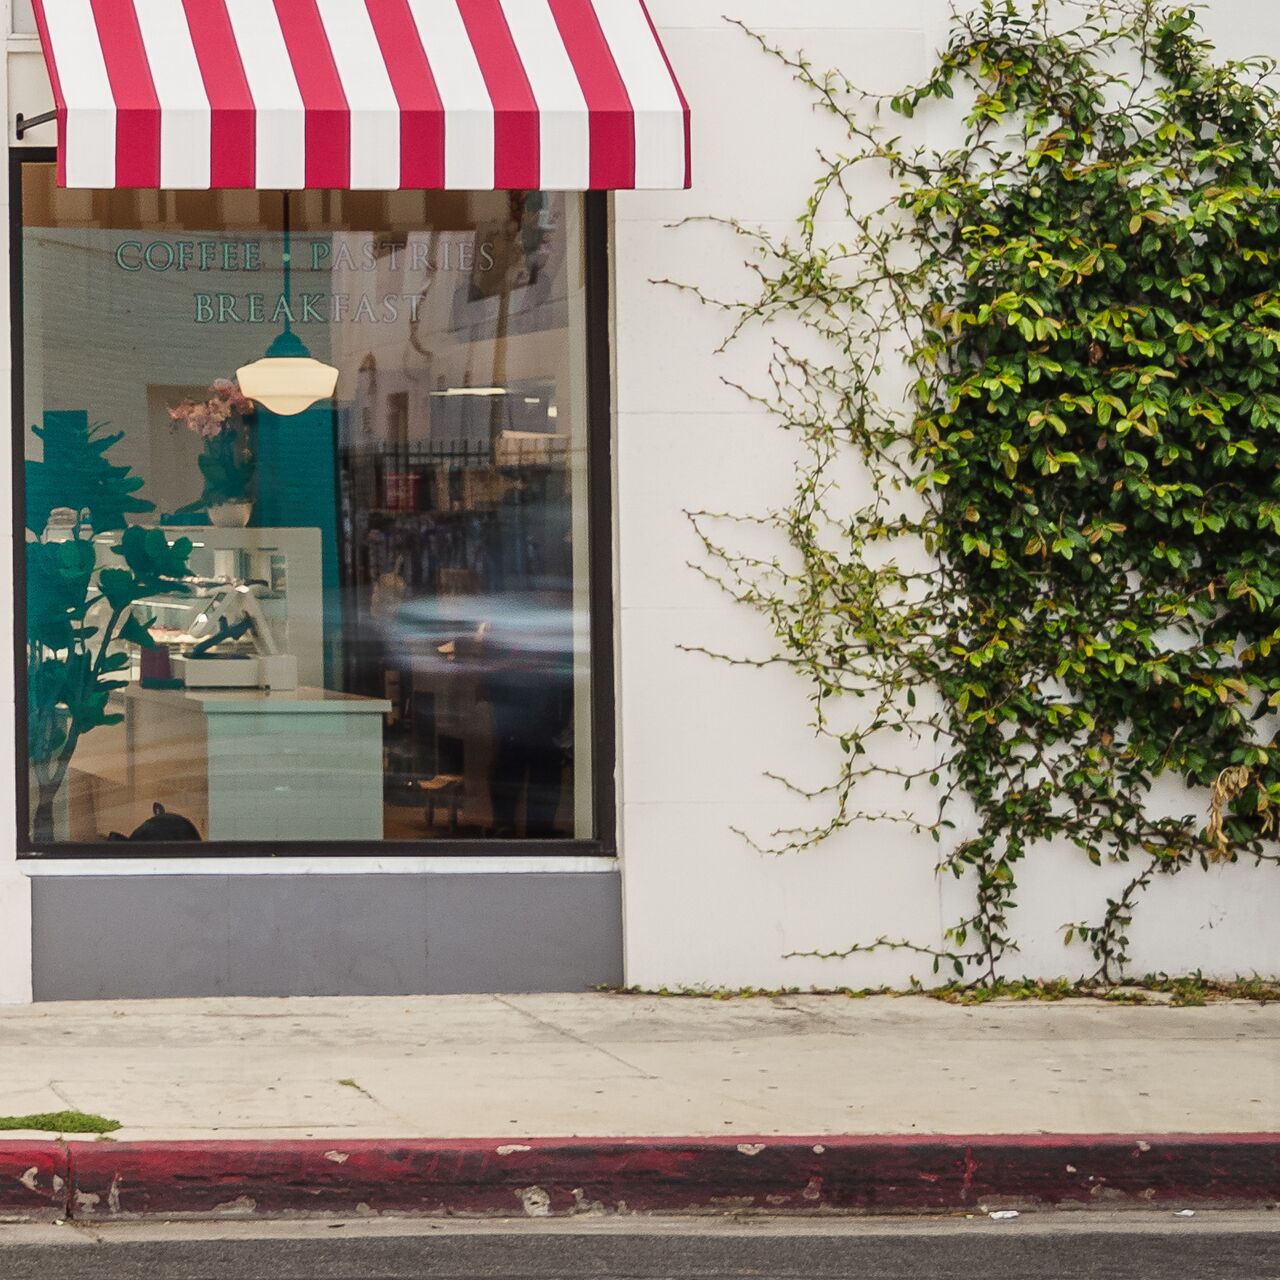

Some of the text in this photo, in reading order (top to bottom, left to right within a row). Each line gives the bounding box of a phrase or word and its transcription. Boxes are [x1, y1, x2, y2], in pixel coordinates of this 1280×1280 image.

[116, 240, 496, 272] COFFEE PASTRIES
[194, 292, 426, 324] BREAKFAST
